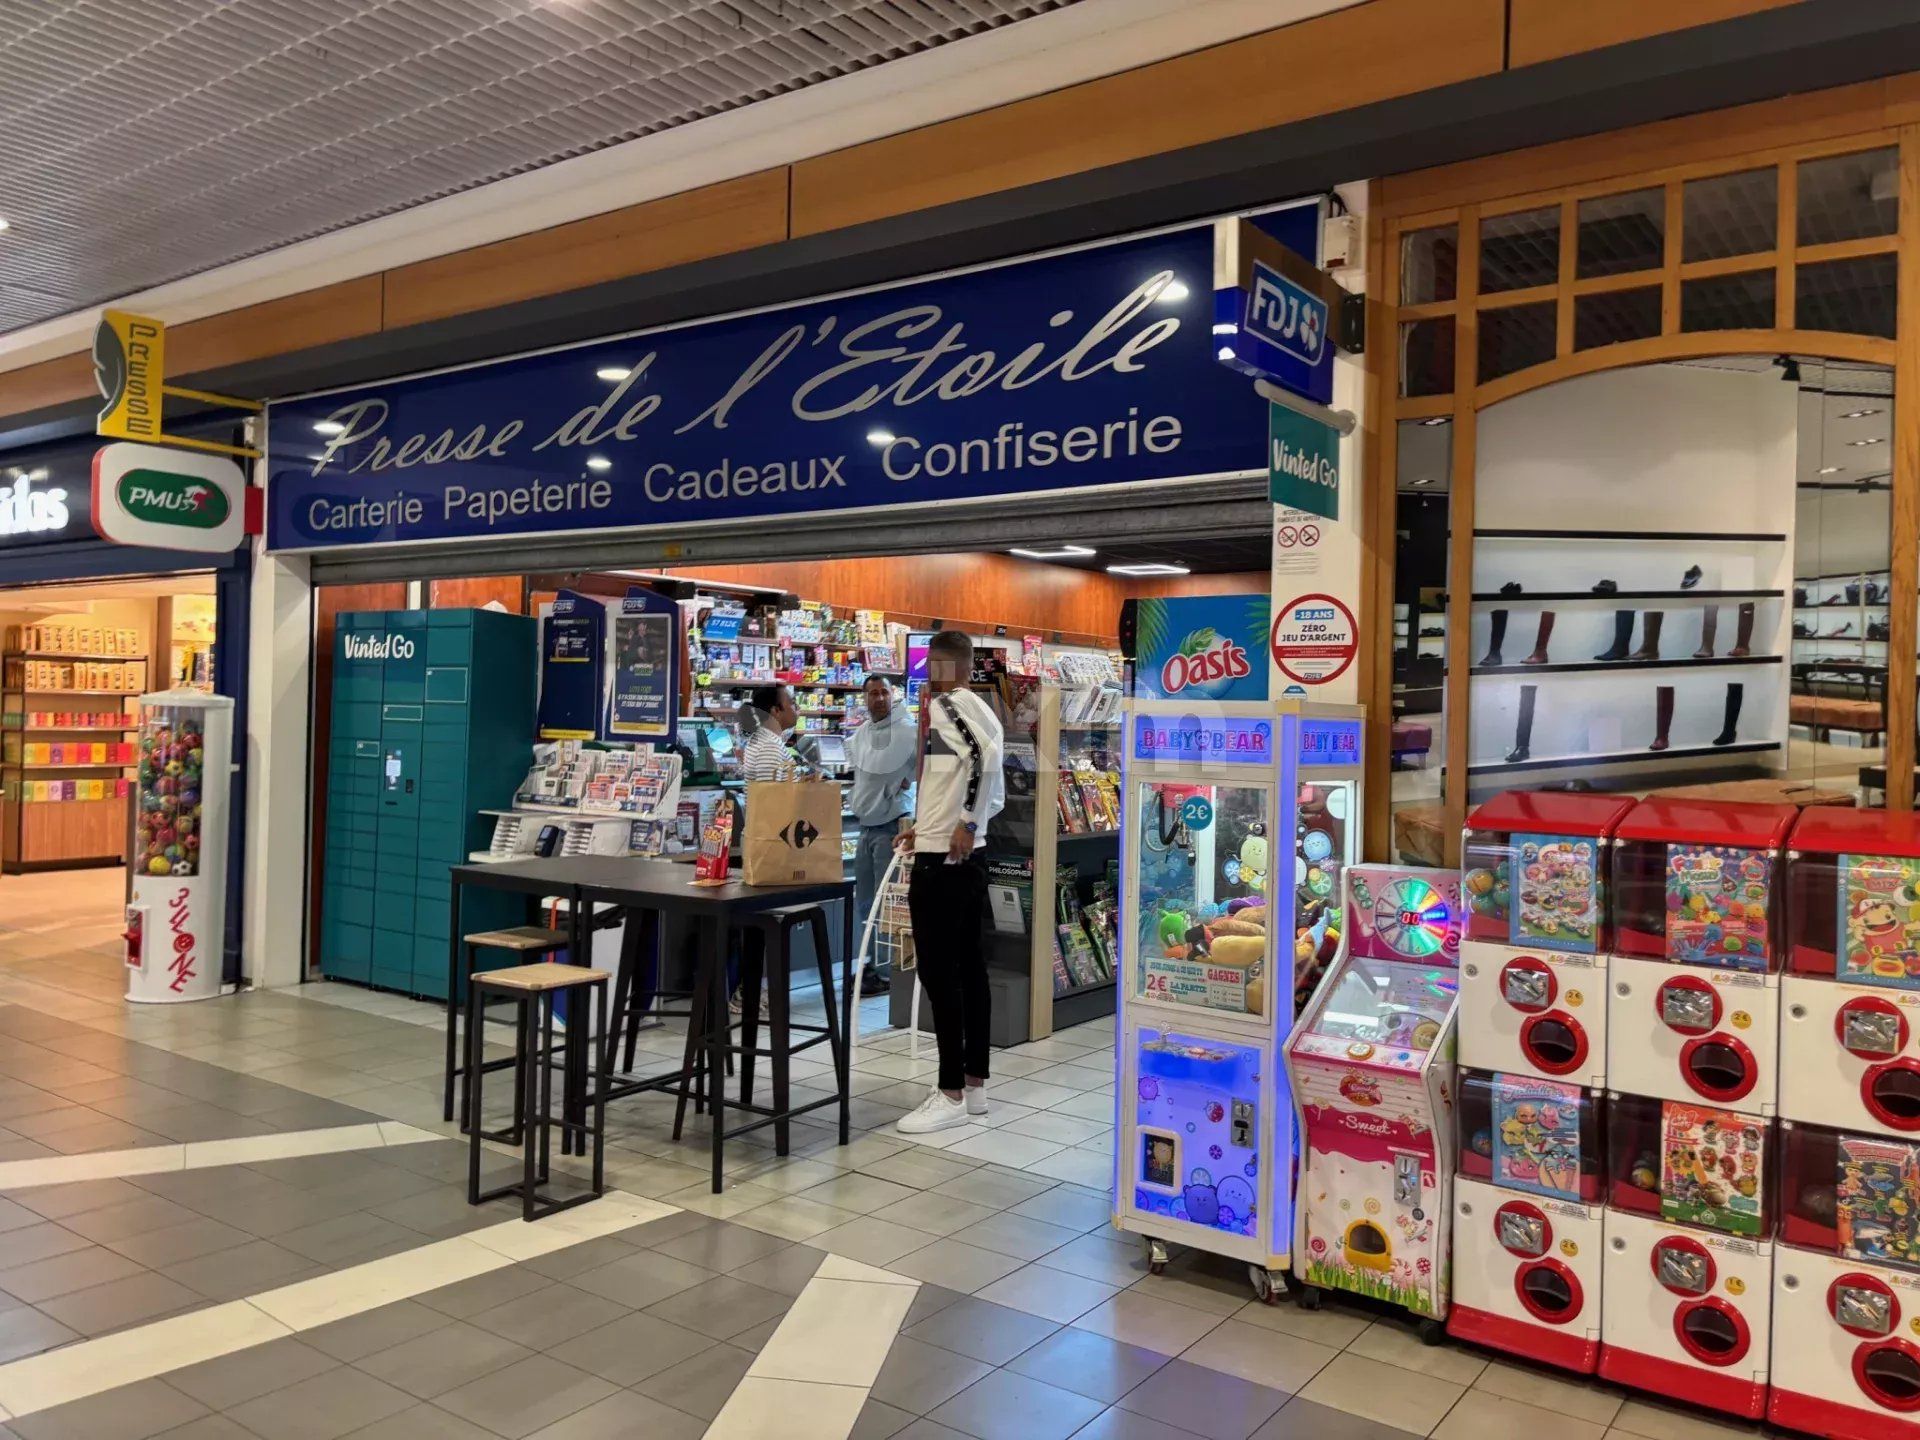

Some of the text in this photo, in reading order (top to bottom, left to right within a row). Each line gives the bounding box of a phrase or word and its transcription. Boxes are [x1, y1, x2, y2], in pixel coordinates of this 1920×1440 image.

[1253, 277, 1298, 340] FDJ
[127, 322, 158, 435] PRESSE
[310, 398, 524, 479] Presse
[532, 351, 662, 452] de
[308, 407, 1182, 532] Carterie Papeterie Cadeaux Confiserie
[1273, 438, 1338, 489] Vinted Go
[129, 486, 183, 511] PMU
[1296, 610, 1333, 619] -18 ANS
[1282, 633, 1347, 642] JEU D'ARGENT
[1301, 623, 1326, 633] ZÉRO
[344, 634, 414, 659] Vinted Go
[1161, 638, 1250, 694] Oasis
[1143, 729, 1265, 751] BABY BEAR
[1303, 733, 1355, 751] BABY BEAR
[1185, 804, 1208, 820] 2€
[988, 866, 1032, 877] PHILOSOPHER
[1402, 912, 1420, 925] 00
[1147, 974, 1168, 992] 2€
[1345, 1115, 1391, 1134] Sweet
